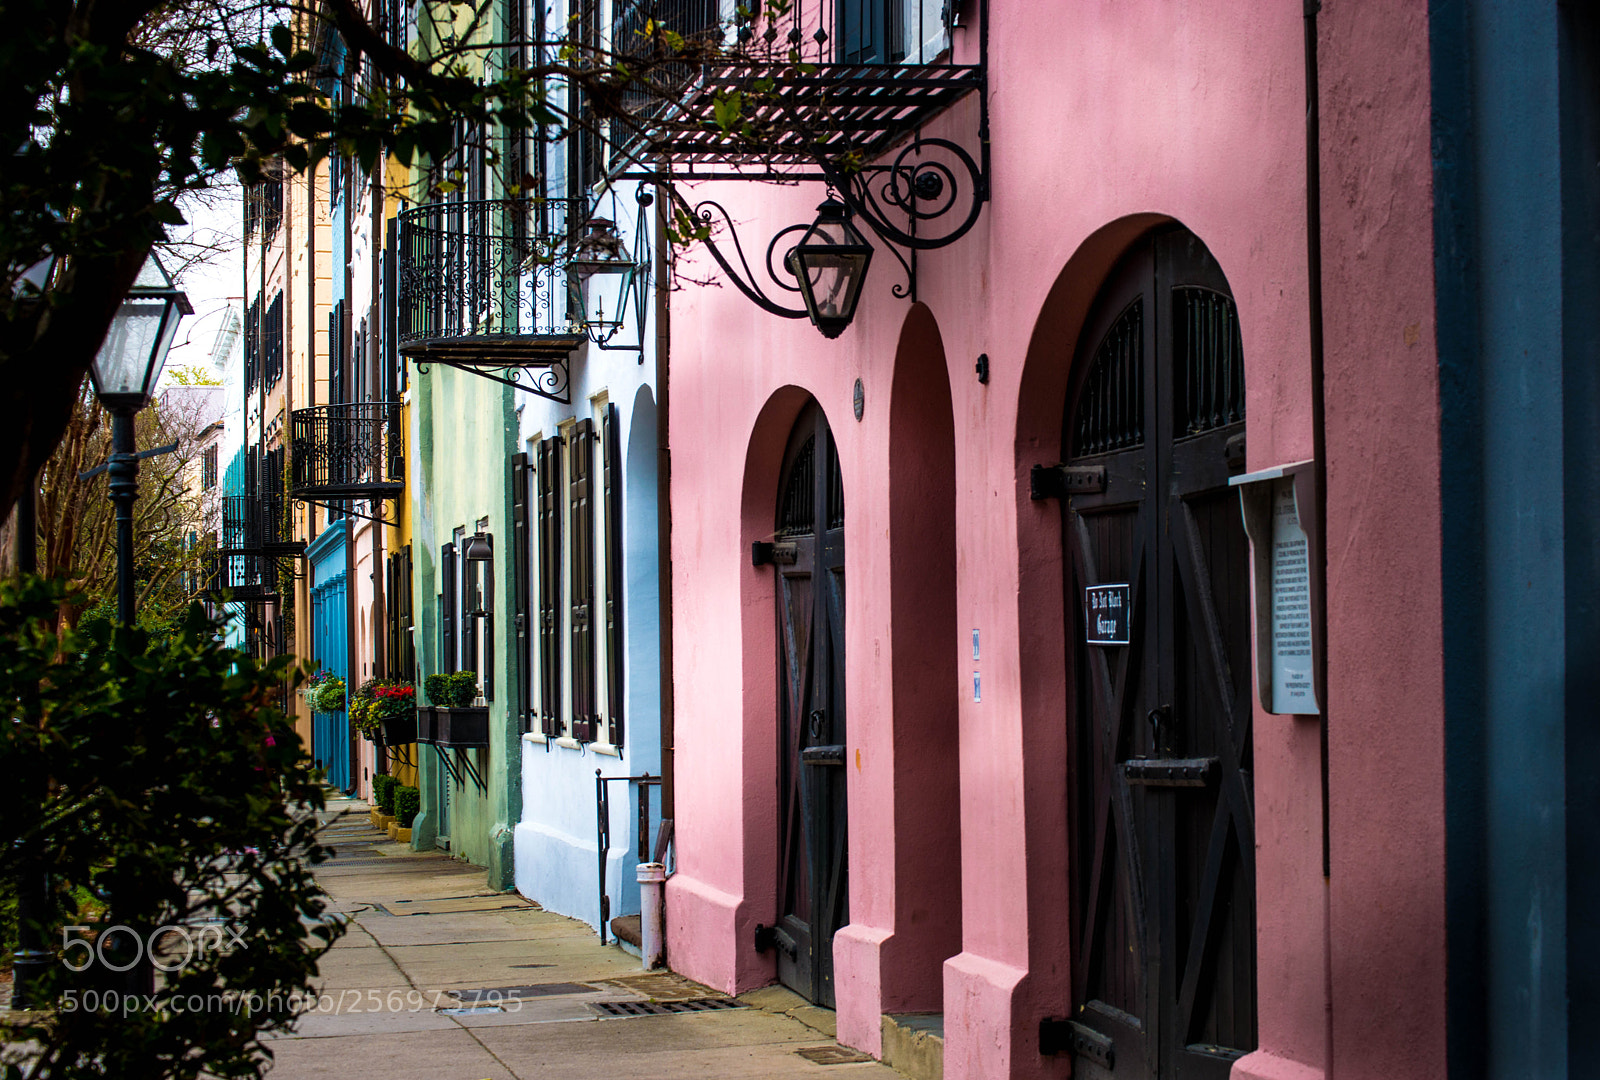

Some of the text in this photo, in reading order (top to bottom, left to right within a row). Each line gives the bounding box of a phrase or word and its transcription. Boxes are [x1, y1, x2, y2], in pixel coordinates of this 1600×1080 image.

[1091, 591, 1122, 609] Do Not Block
[1097, 613, 1117, 639] Garage
